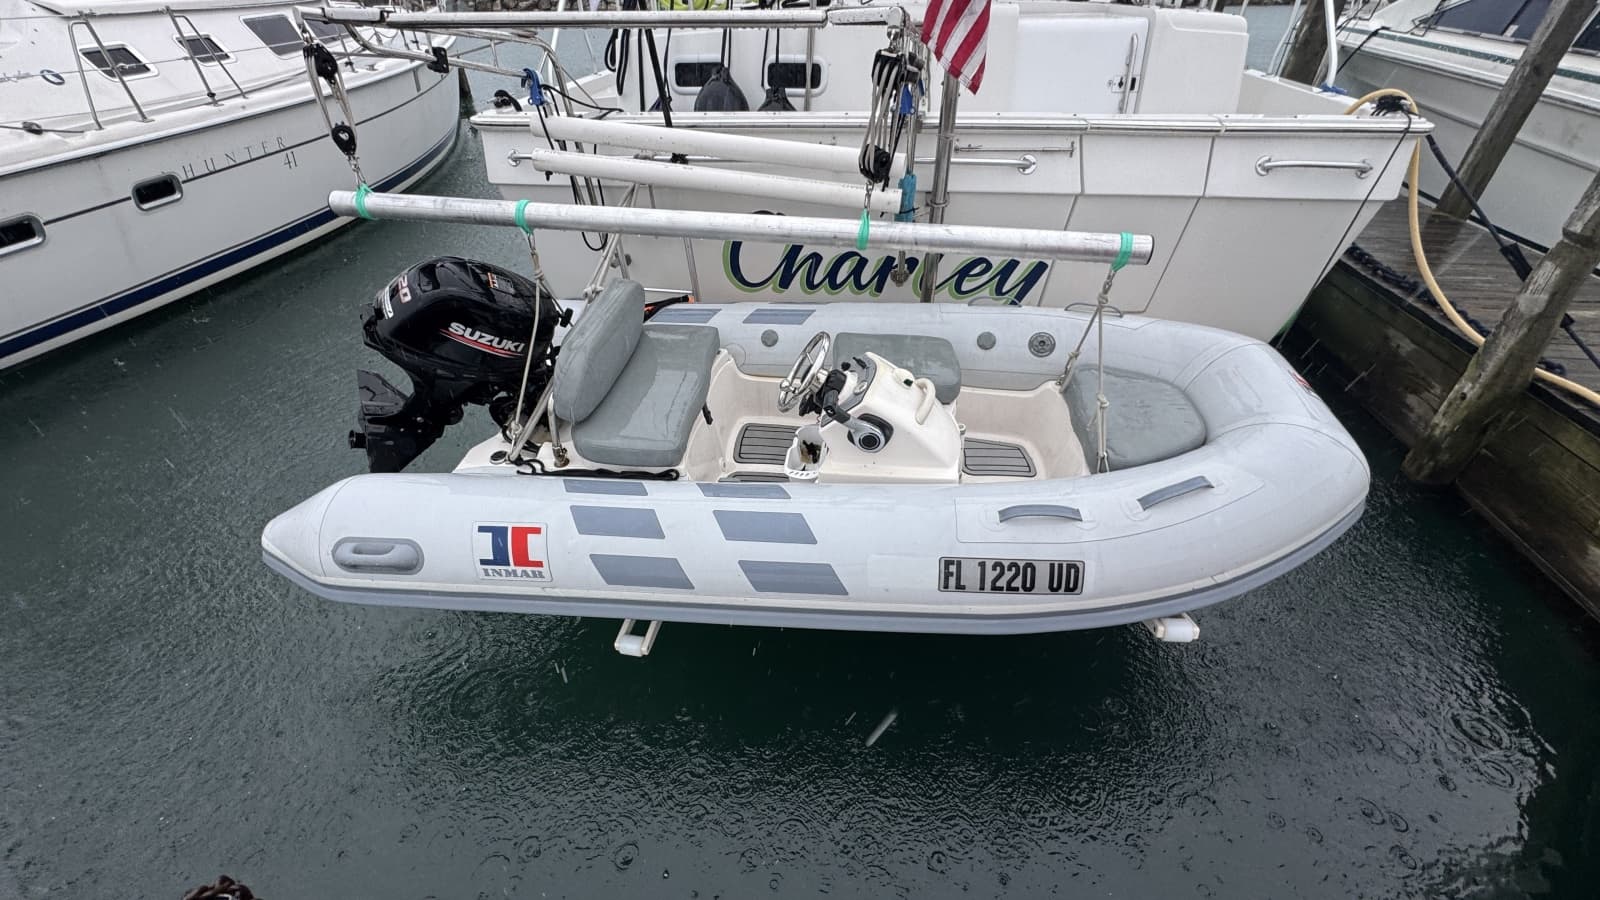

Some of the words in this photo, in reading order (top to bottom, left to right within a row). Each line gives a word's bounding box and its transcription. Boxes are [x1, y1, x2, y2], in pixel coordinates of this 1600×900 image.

[182, 136, 287, 179] HUNTER
[284, 150, 298, 170] 41
[722, 210, 1049, 305] Charey
[448, 321, 525, 353] SUZUKI
[482, 567, 546, 579] INMAR
[943, 559, 966, 590] FL
[978, 560, 1037, 593] 1220
[1048, 562, 1080, 593] UD
